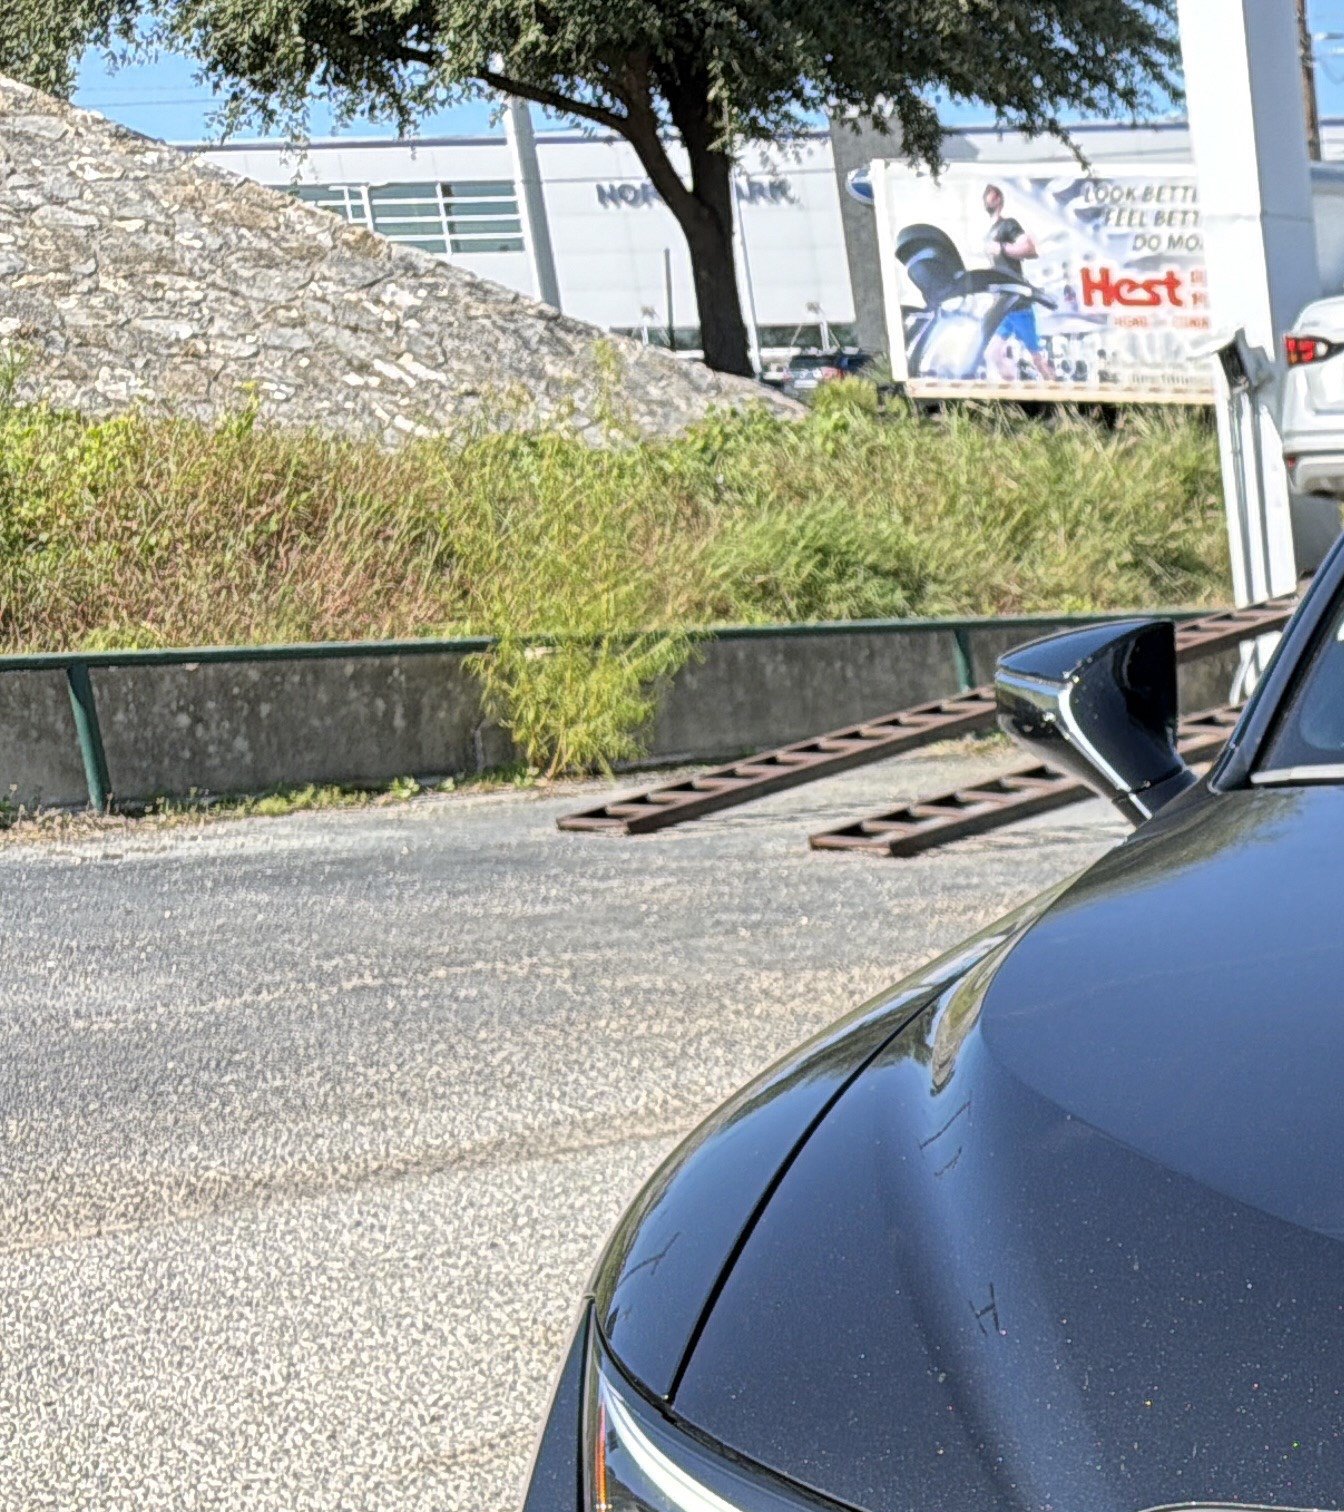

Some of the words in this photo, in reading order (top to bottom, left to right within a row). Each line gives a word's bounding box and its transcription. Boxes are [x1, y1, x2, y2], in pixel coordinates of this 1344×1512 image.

[1085, 185, 1136, 203] LOOK
[1104, 208, 1146, 227] FEEL
[1132, 233, 1160, 251] DO
[1166, 233, 1203, 252] MO
[1080, 266, 1184, 307] Hest
